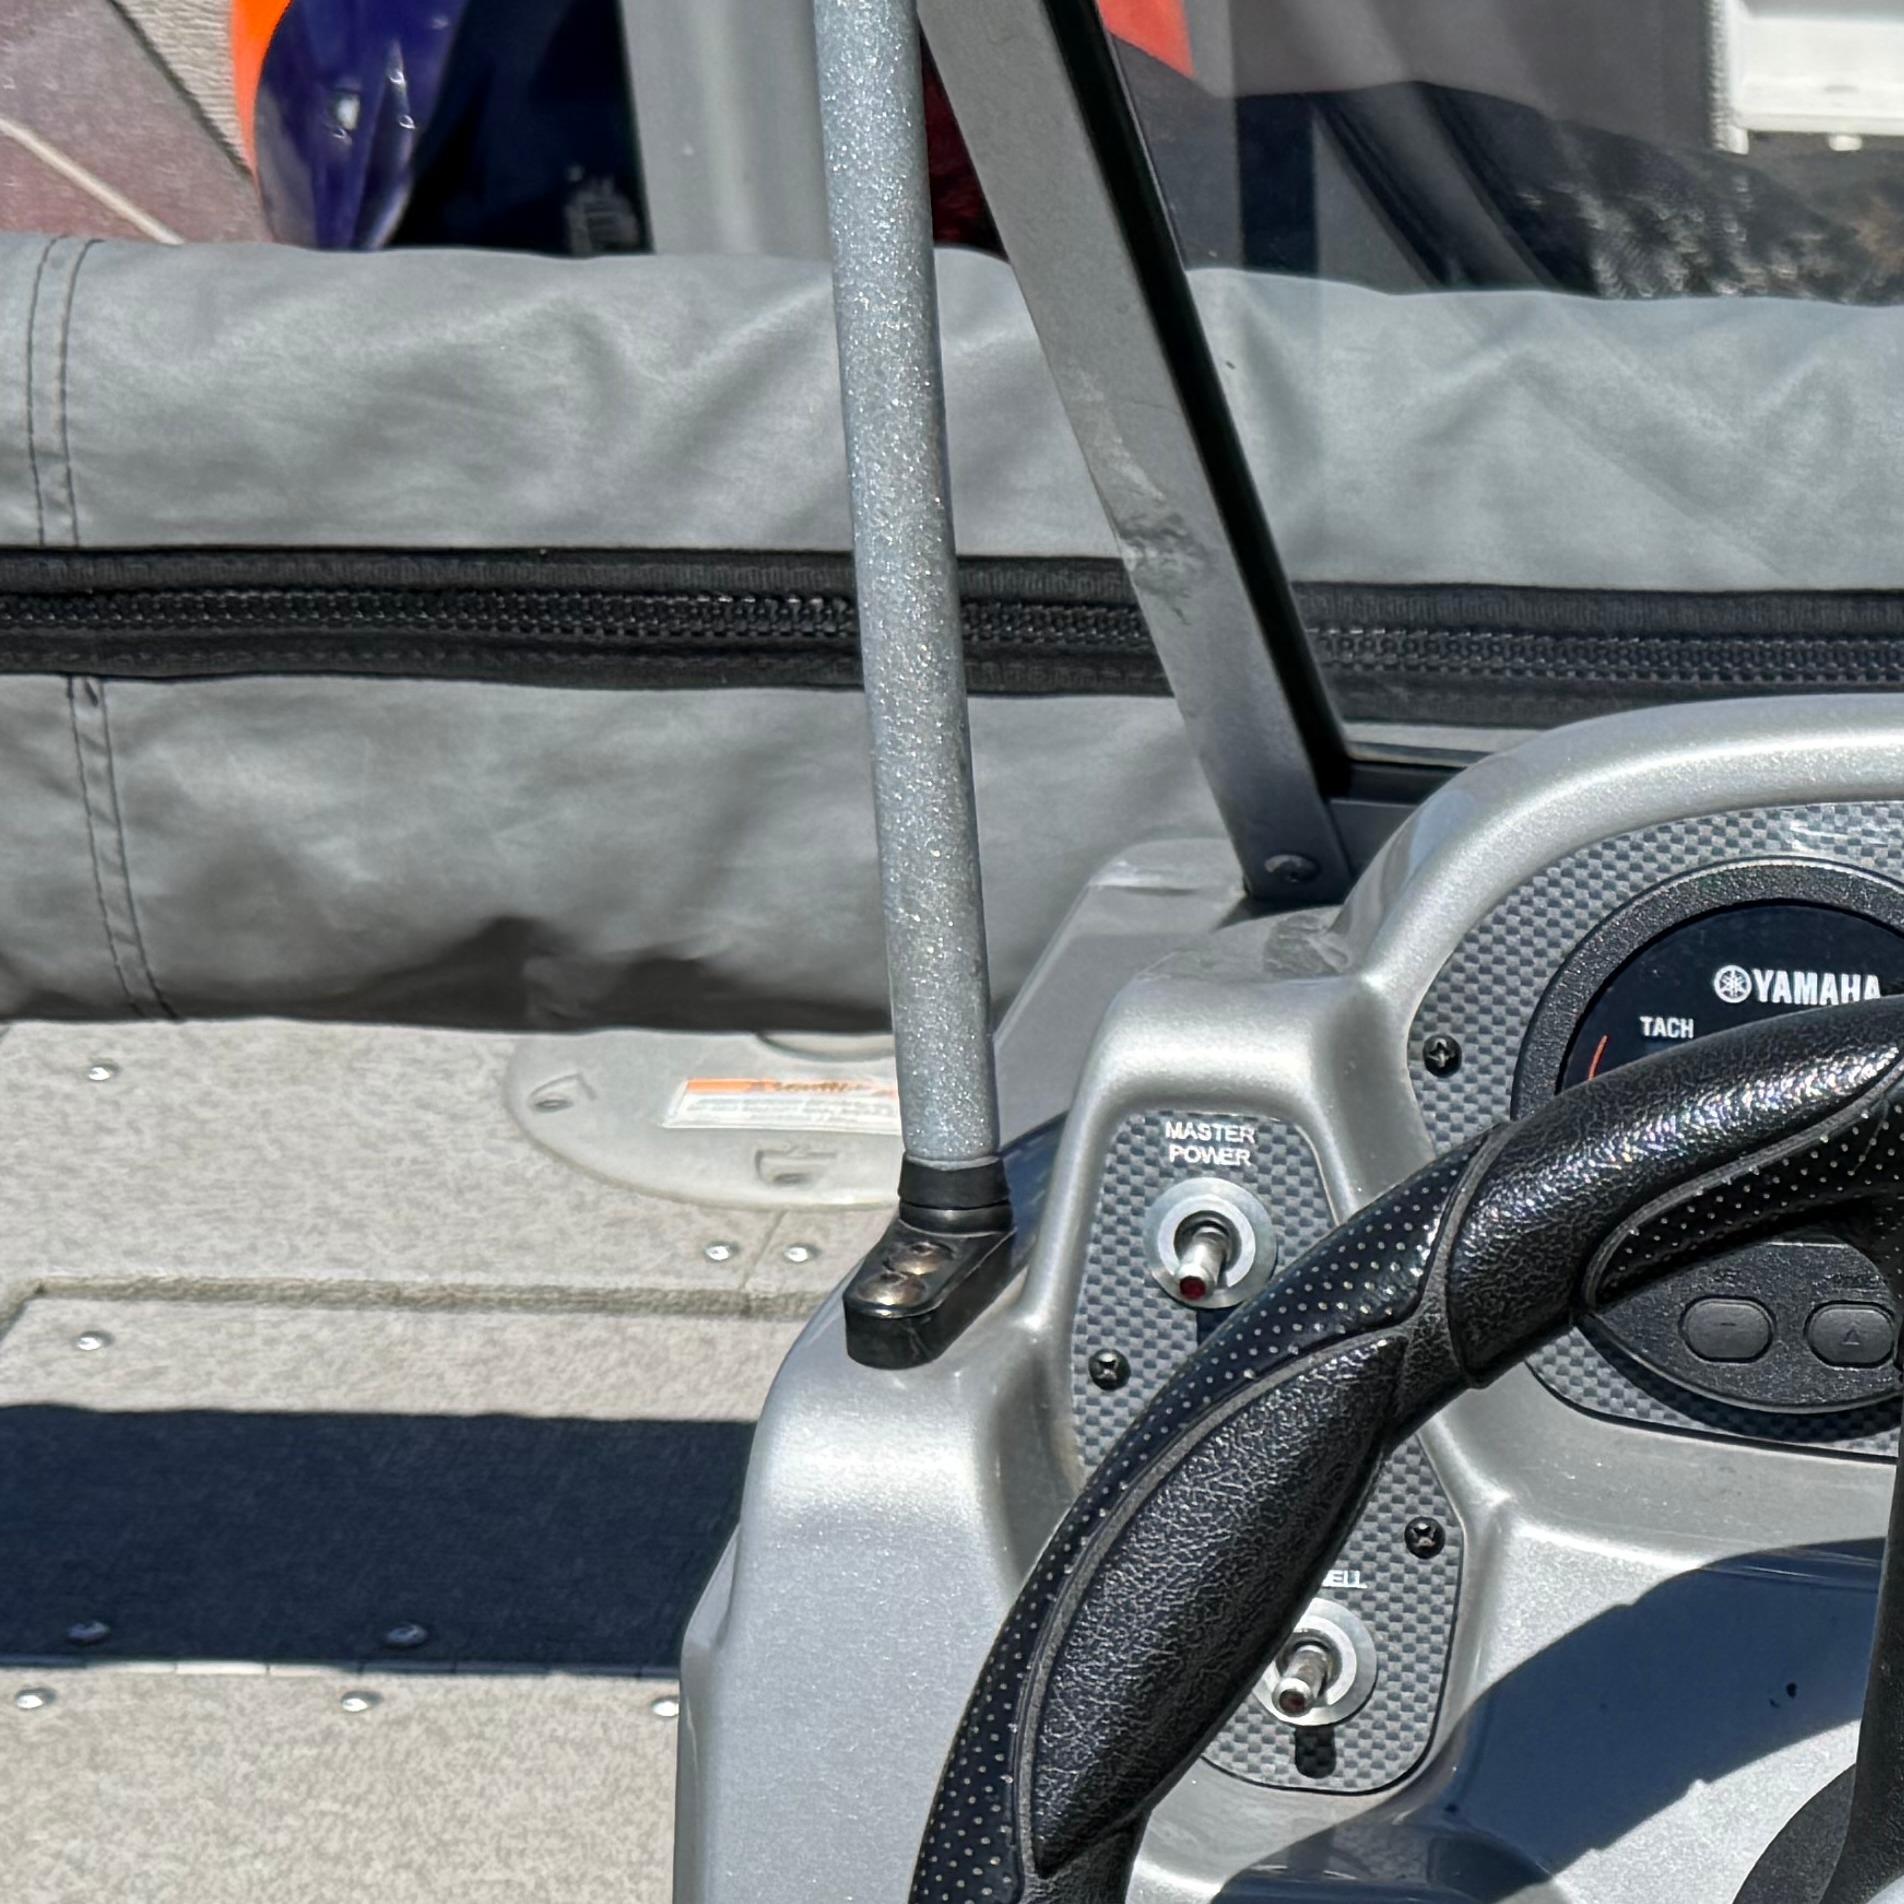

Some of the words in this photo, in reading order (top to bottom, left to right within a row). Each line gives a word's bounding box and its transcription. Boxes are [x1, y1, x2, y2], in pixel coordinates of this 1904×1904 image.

[1752, 967, 1881, 1005] YAMAHA
[1639, 1015, 1694, 1040] TACH
[1164, 1120, 1256, 1144] MASTER
[1168, 1144, 1252, 1168] POWER
